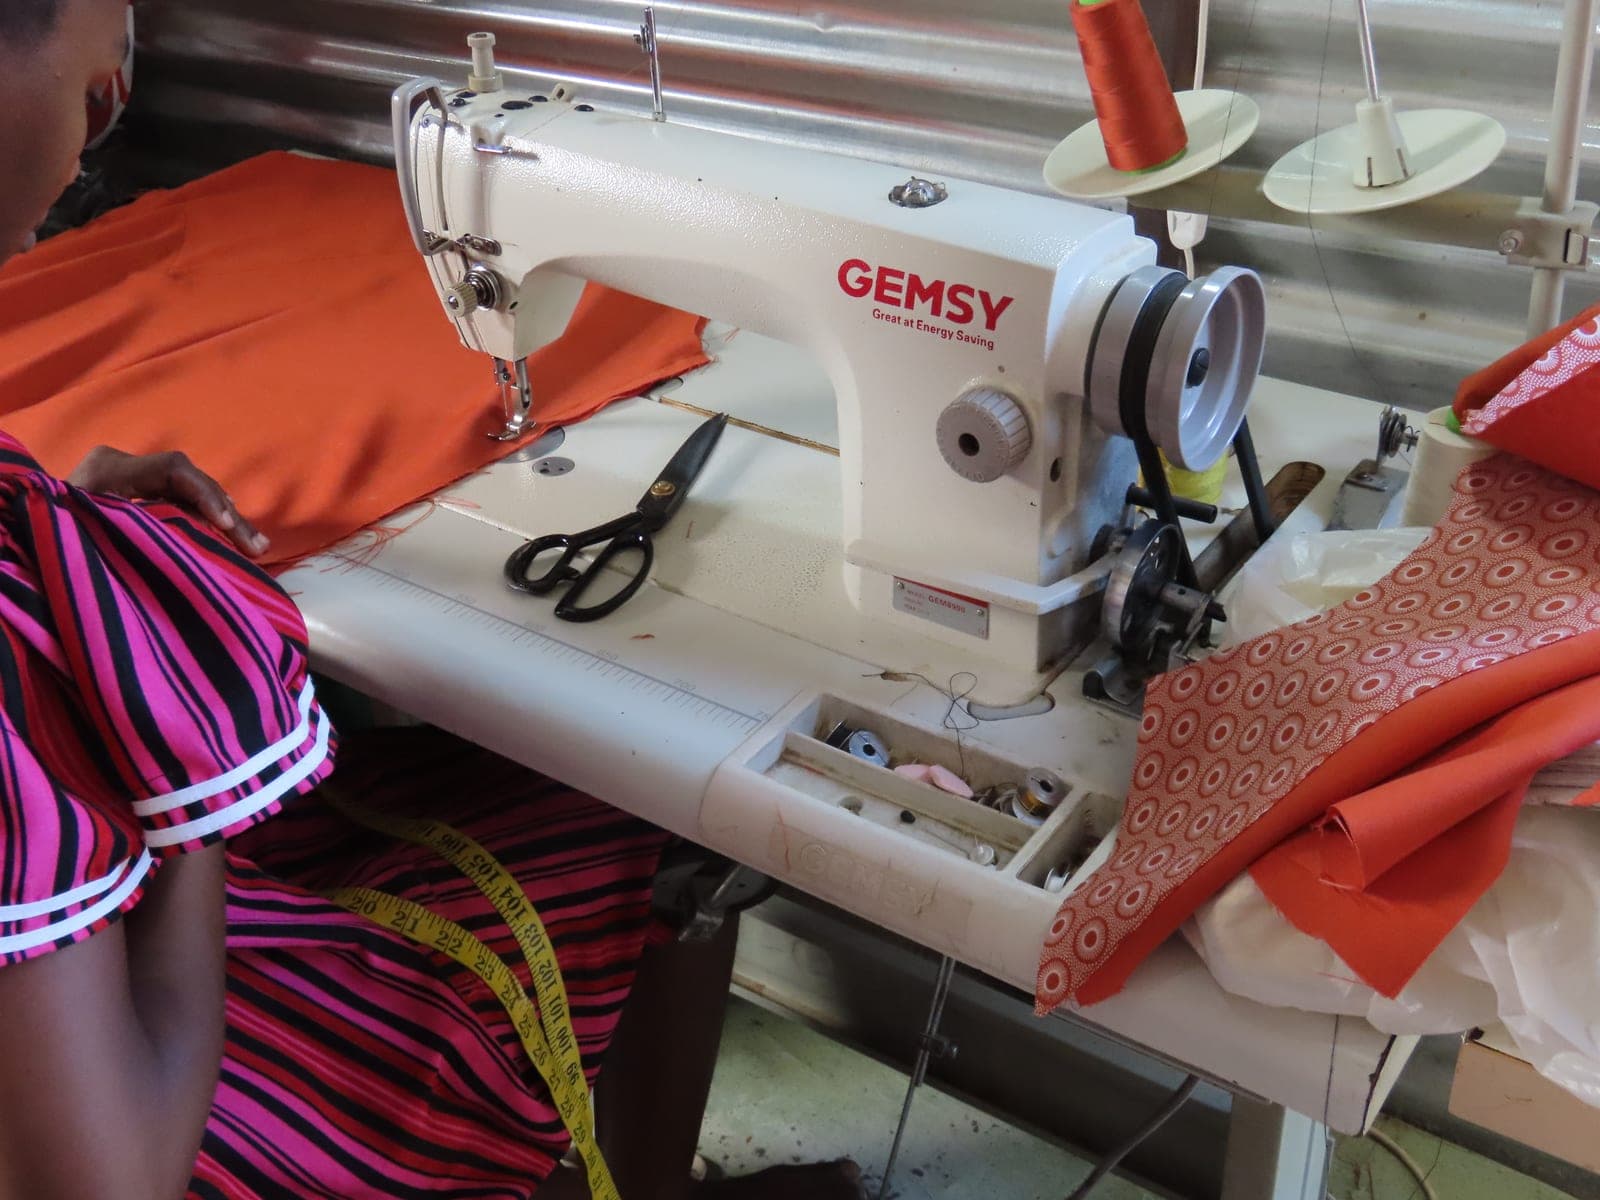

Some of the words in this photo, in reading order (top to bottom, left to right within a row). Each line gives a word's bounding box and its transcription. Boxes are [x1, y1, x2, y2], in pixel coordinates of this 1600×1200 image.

[837, 258, 1014, 331] GEMSY
[872, 308, 901, 325] Great
[903, 316, 914, 328] at
[916, 319, 954, 340] Energy
[956, 330, 995, 351] Saving
[348, 896, 377, 915] 20
[391, 911, 419, 934] 21
[434, 930, 463, 954] 22
[474, 954, 495, 980] 23
[501, 984, 517, 1009] 24
[519, 1014, 532, 1039] 25
[549, 1068, 561, 1092] 27
[561, 1095, 575, 1119] 28
[470, 854, 500, 883] 105
[499, 884, 527, 920] 104
[525, 923, 546, 958] 103
[539, 959, 558, 993] 102
[549, 994, 565, 1024] 101
[557, 1026, 572, 1056] 100
[566, 1062, 580, 1086] 99
